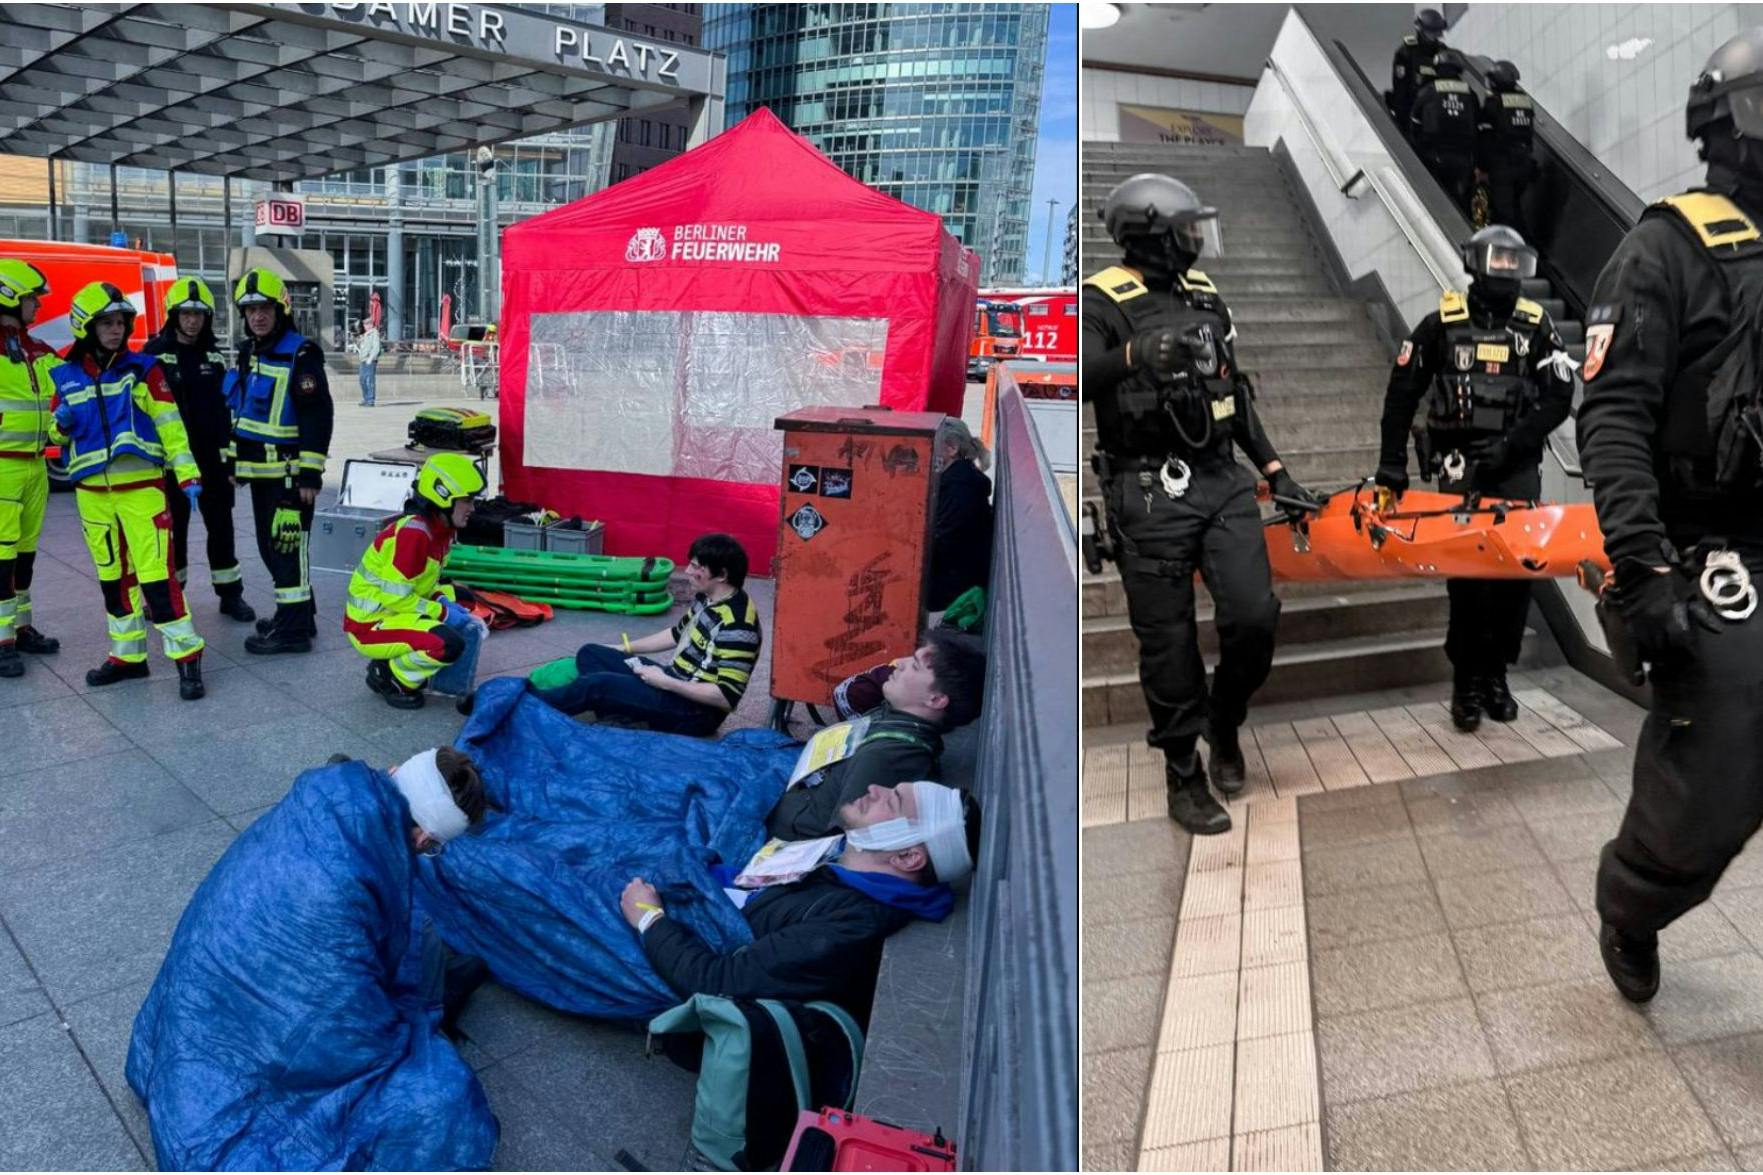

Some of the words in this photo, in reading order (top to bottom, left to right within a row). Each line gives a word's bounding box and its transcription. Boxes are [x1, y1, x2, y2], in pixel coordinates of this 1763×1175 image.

[332, 3, 504, 41] AMER
[555, 26, 679, 77] PLATZ
[273, 204, 298, 222] DB
[674, 225, 747, 241] BERLINER
[671, 242, 781, 262] FEUERWEHR
[1023, 331, 1058, 349] 112
